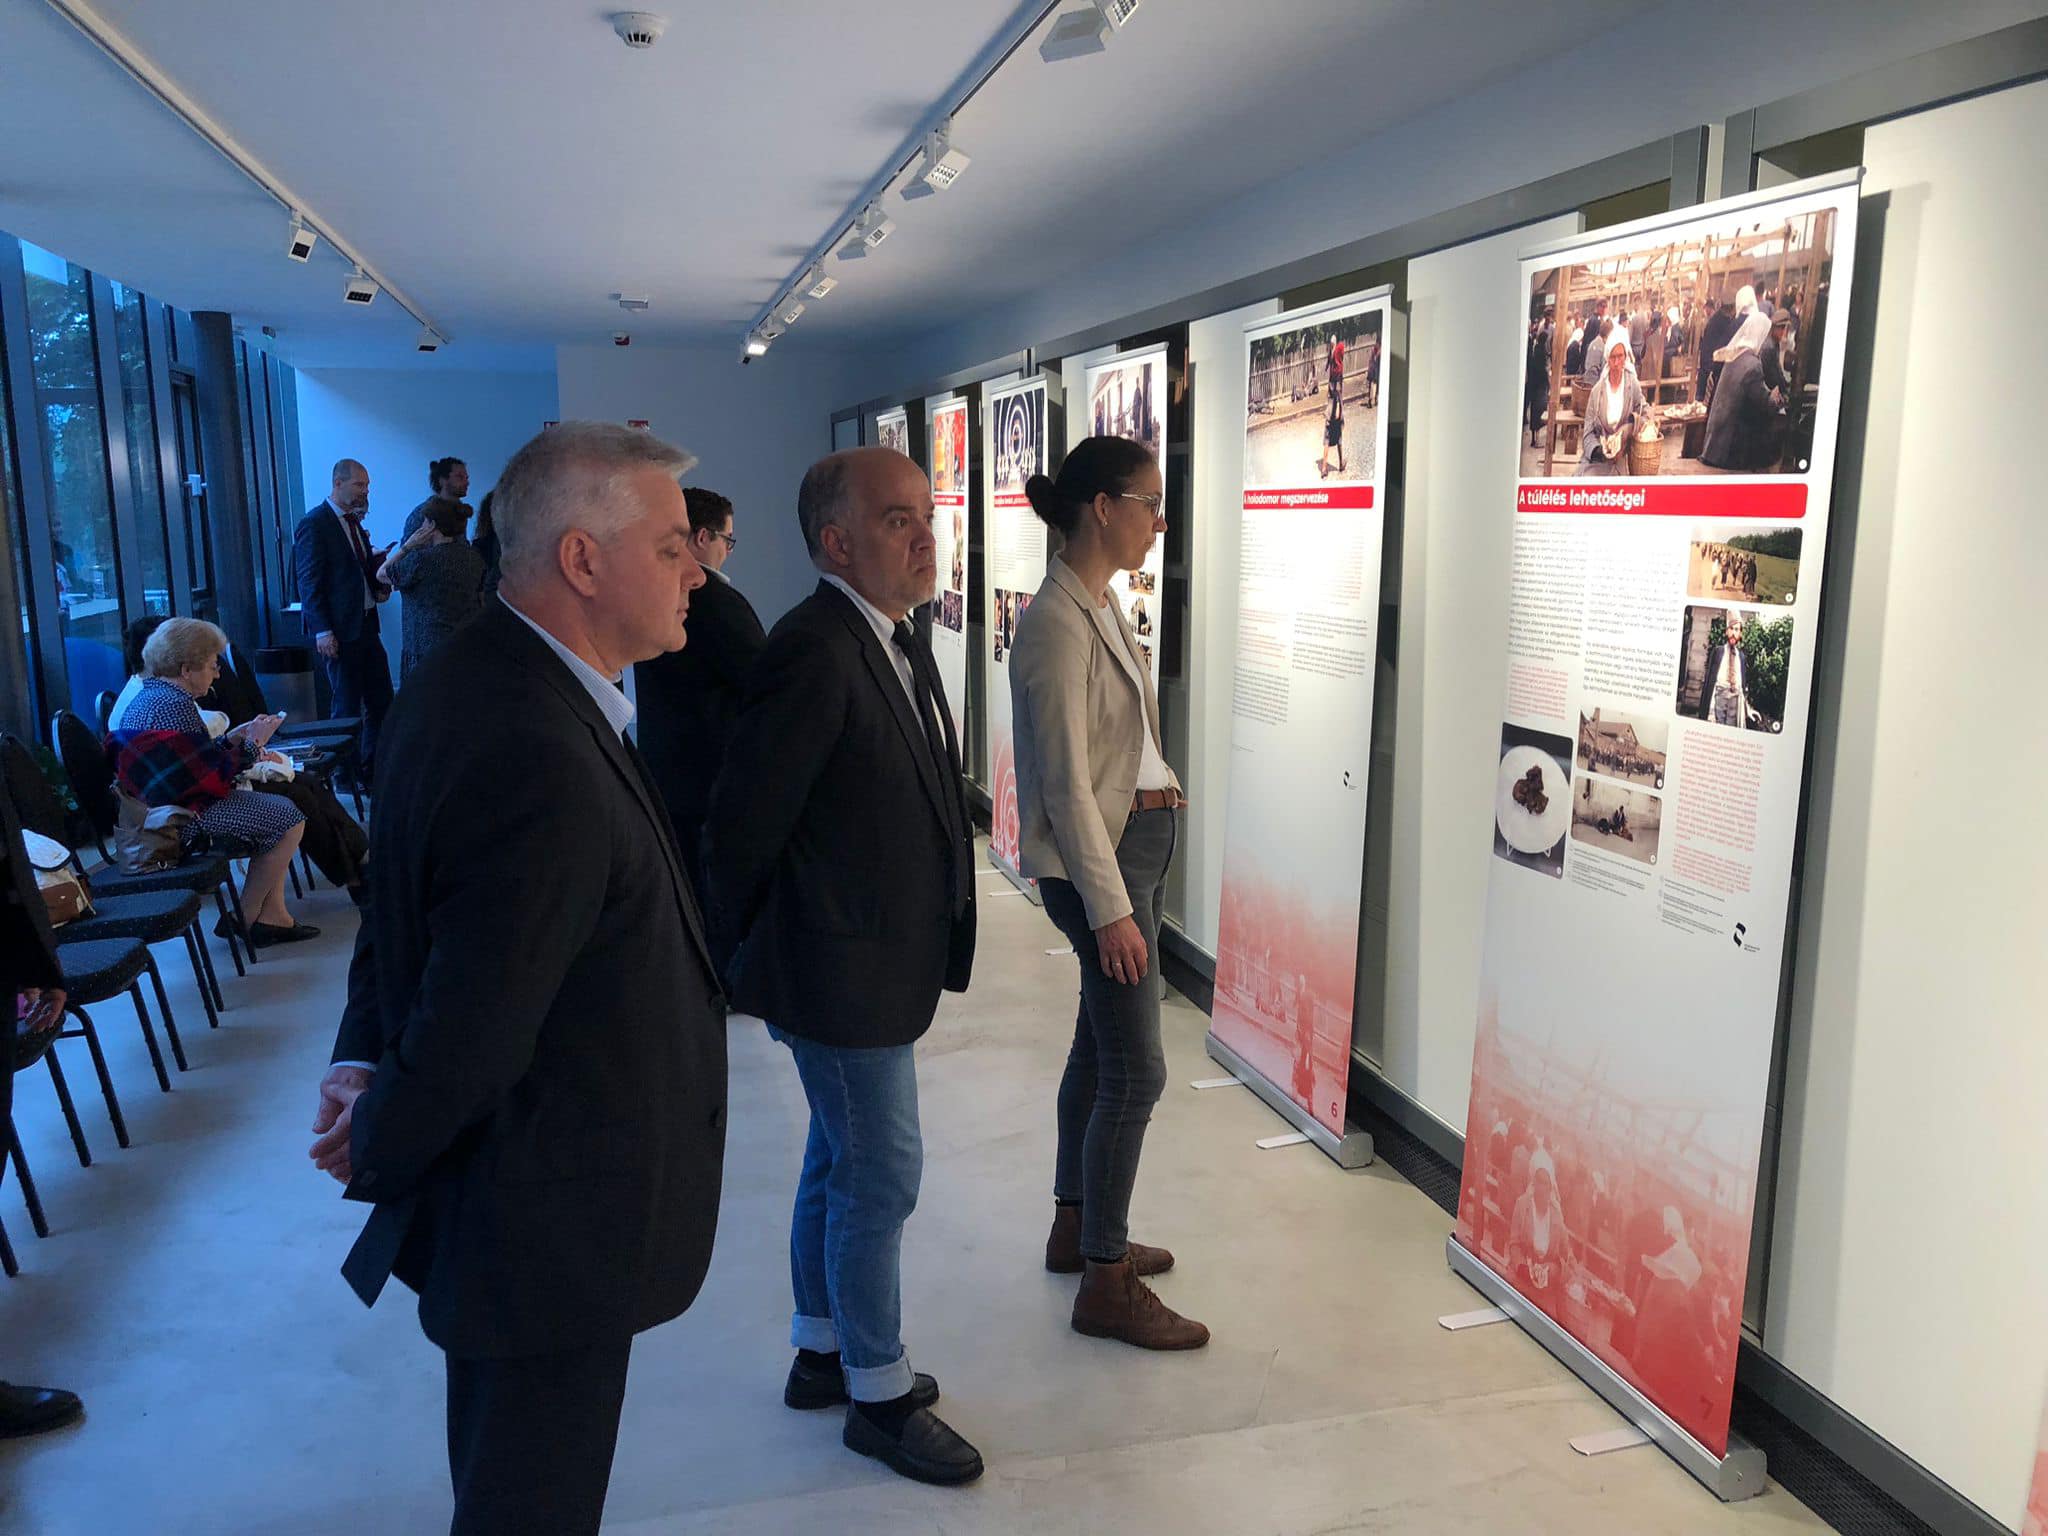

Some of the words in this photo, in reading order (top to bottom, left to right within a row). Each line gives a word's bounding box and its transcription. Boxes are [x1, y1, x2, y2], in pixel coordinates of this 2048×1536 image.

[1519, 489, 1525, 504] A
[1527, 488, 1567, 505] túlélés
[1569, 488, 1646, 511] lehetőségei
[1331, 1102, 1338, 1118] 6
[1700, 1395, 1714, 1419] 7
